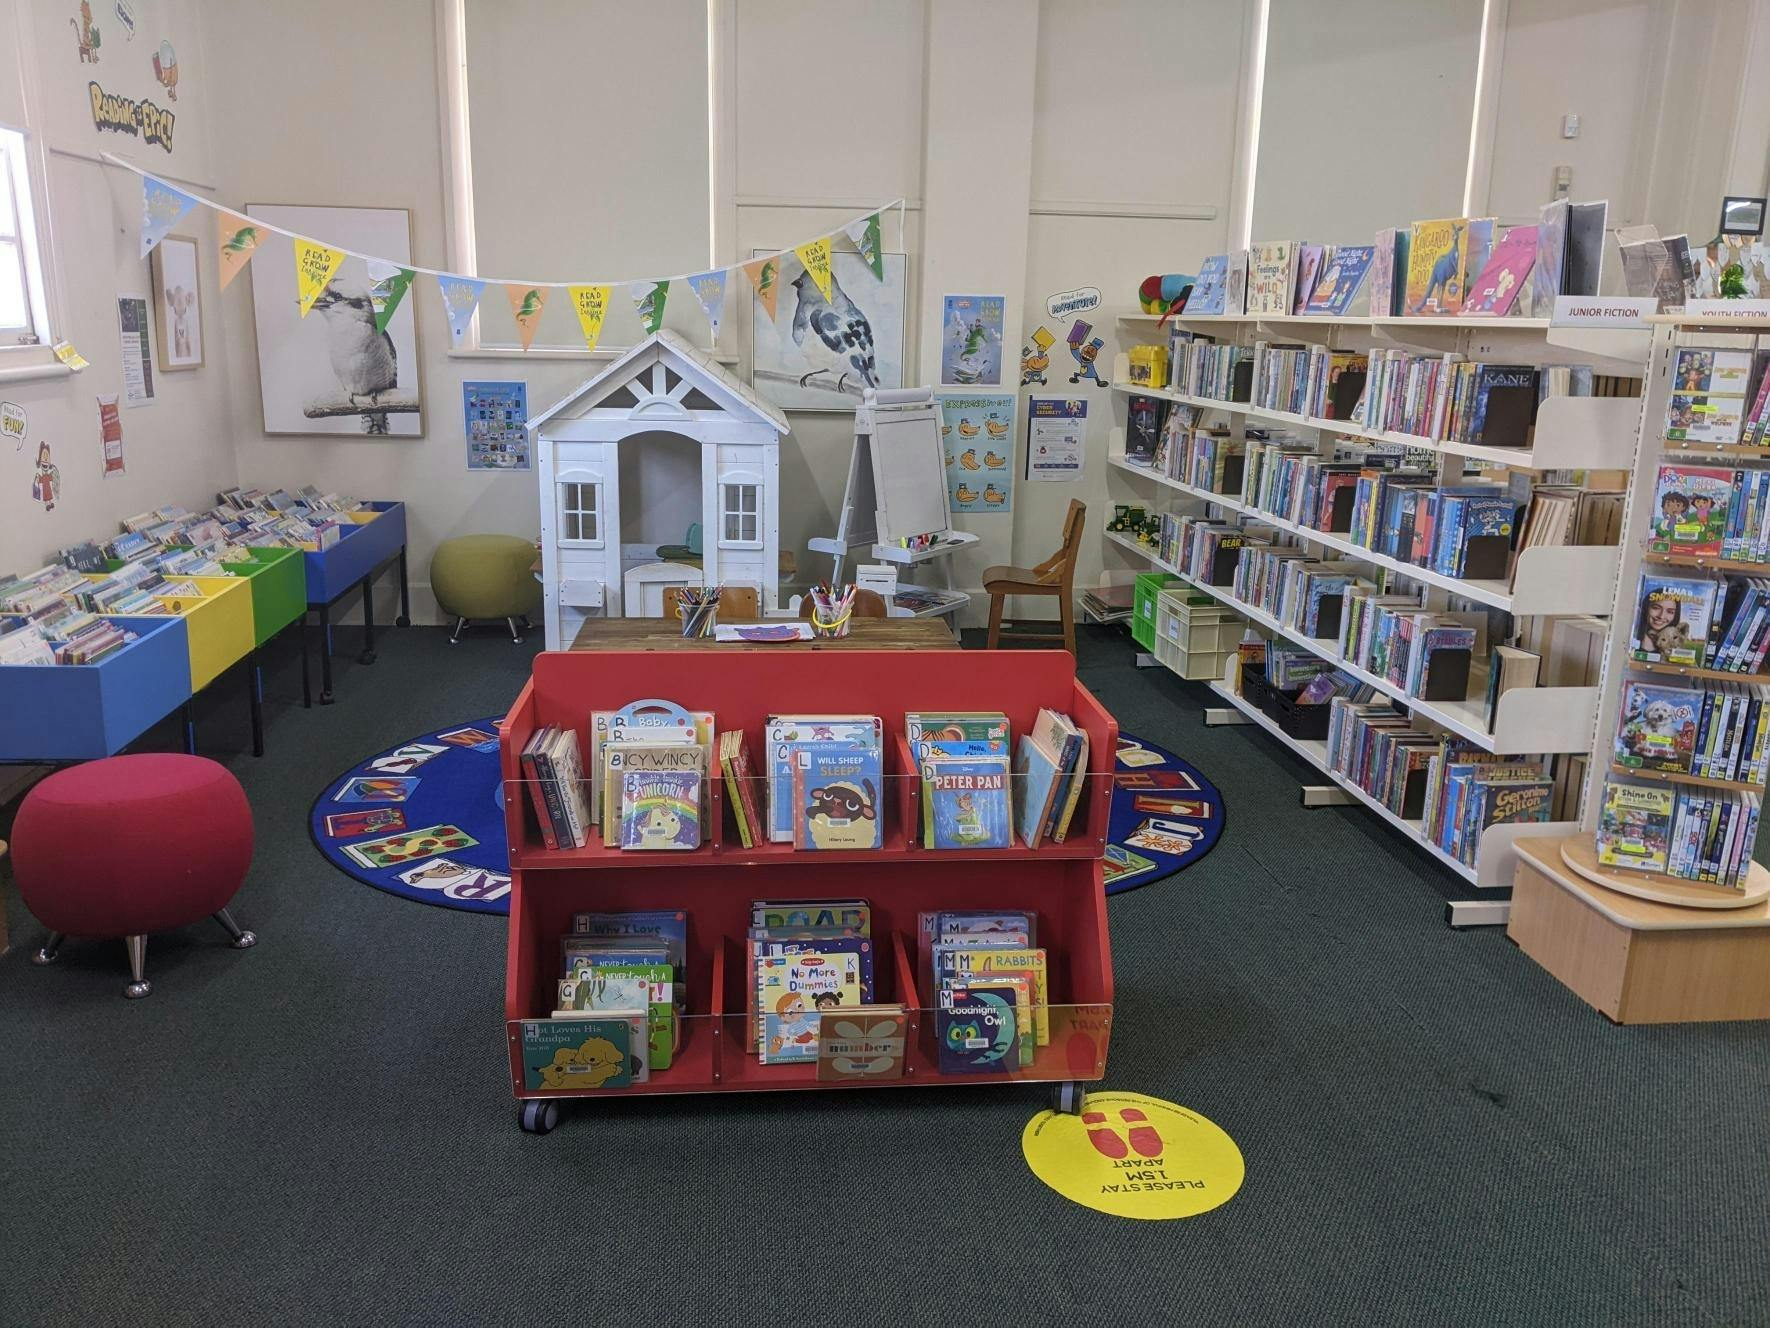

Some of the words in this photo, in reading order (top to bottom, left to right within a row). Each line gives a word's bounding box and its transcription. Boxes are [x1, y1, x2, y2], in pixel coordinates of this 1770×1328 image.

[304, 248, 331, 262] READ
[806, 245, 824, 257] READ
[302, 257, 330, 272] GROW
[807, 254, 827, 264] GROW
[1256, 265, 1280, 277] Feelings
[1256, 281, 1278, 294] WILD
[580, 291, 602, 300] READ
[580, 300, 603, 309] GROW
[1568, 307, 1602, 317] JUNIOR
[1603, 307, 1640, 318] FICTION
[1483, 374, 1530, 386] KANE
[1221, 538, 1242, 549] BEAR
[1662, 586, 1686, 595] LENA
[597, 717, 607, 731] B
[911, 724, 921, 741] D
[920, 744, 930, 758] D
[968, 744, 987, 753] Hello,
[611, 754, 621, 766] B
[621, 753, 649, 766] NCY
[651, 752, 700, 766] WINCY
[799, 753, 808, 767] L
[817, 757, 837, 765] WILL
[838, 757, 864, 765] SHEEP
[820, 766, 862, 777] SLEEP?
[924, 766, 934, 781] D
[1488, 767, 1535, 777] JUSTICE
[627, 776, 637, 792] B
[935, 775, 974, 790] PETER
[977, 775, 1002, 789] PAN
[639, 782, 685, 798] UNICORN
[1621, 789, 1646, 799] Shine
[1646, 791, 1658, 800] On
[1496, 786, 1549, 807] Geronimo
[1492, 797, 1540, 823] Stilton
[995, 954, 1043, 966] RABBITS
[605, 972, 627, 980] NEVER
[790, 967, 805, 979] No
[808, 967, 837, 979] More
[789, 979, 838, 992] Dummies
[948, 1004, 1000, 1016] Goodnight,
[984, 1015, 1006, 1026] Owl
[551, 1025, 581, 1034] Loves
[584, 1025, 602, 1033] His
[525, 1033, 571, 1043] Grandpa
[1112, 1158, 1164, 1168] APART
[1126, 1169, 1168, 1181] 1.5M
[1100, 1182, 1144, 1194] STAY
[1144, 1180, 1206, 1191] PLEASE
